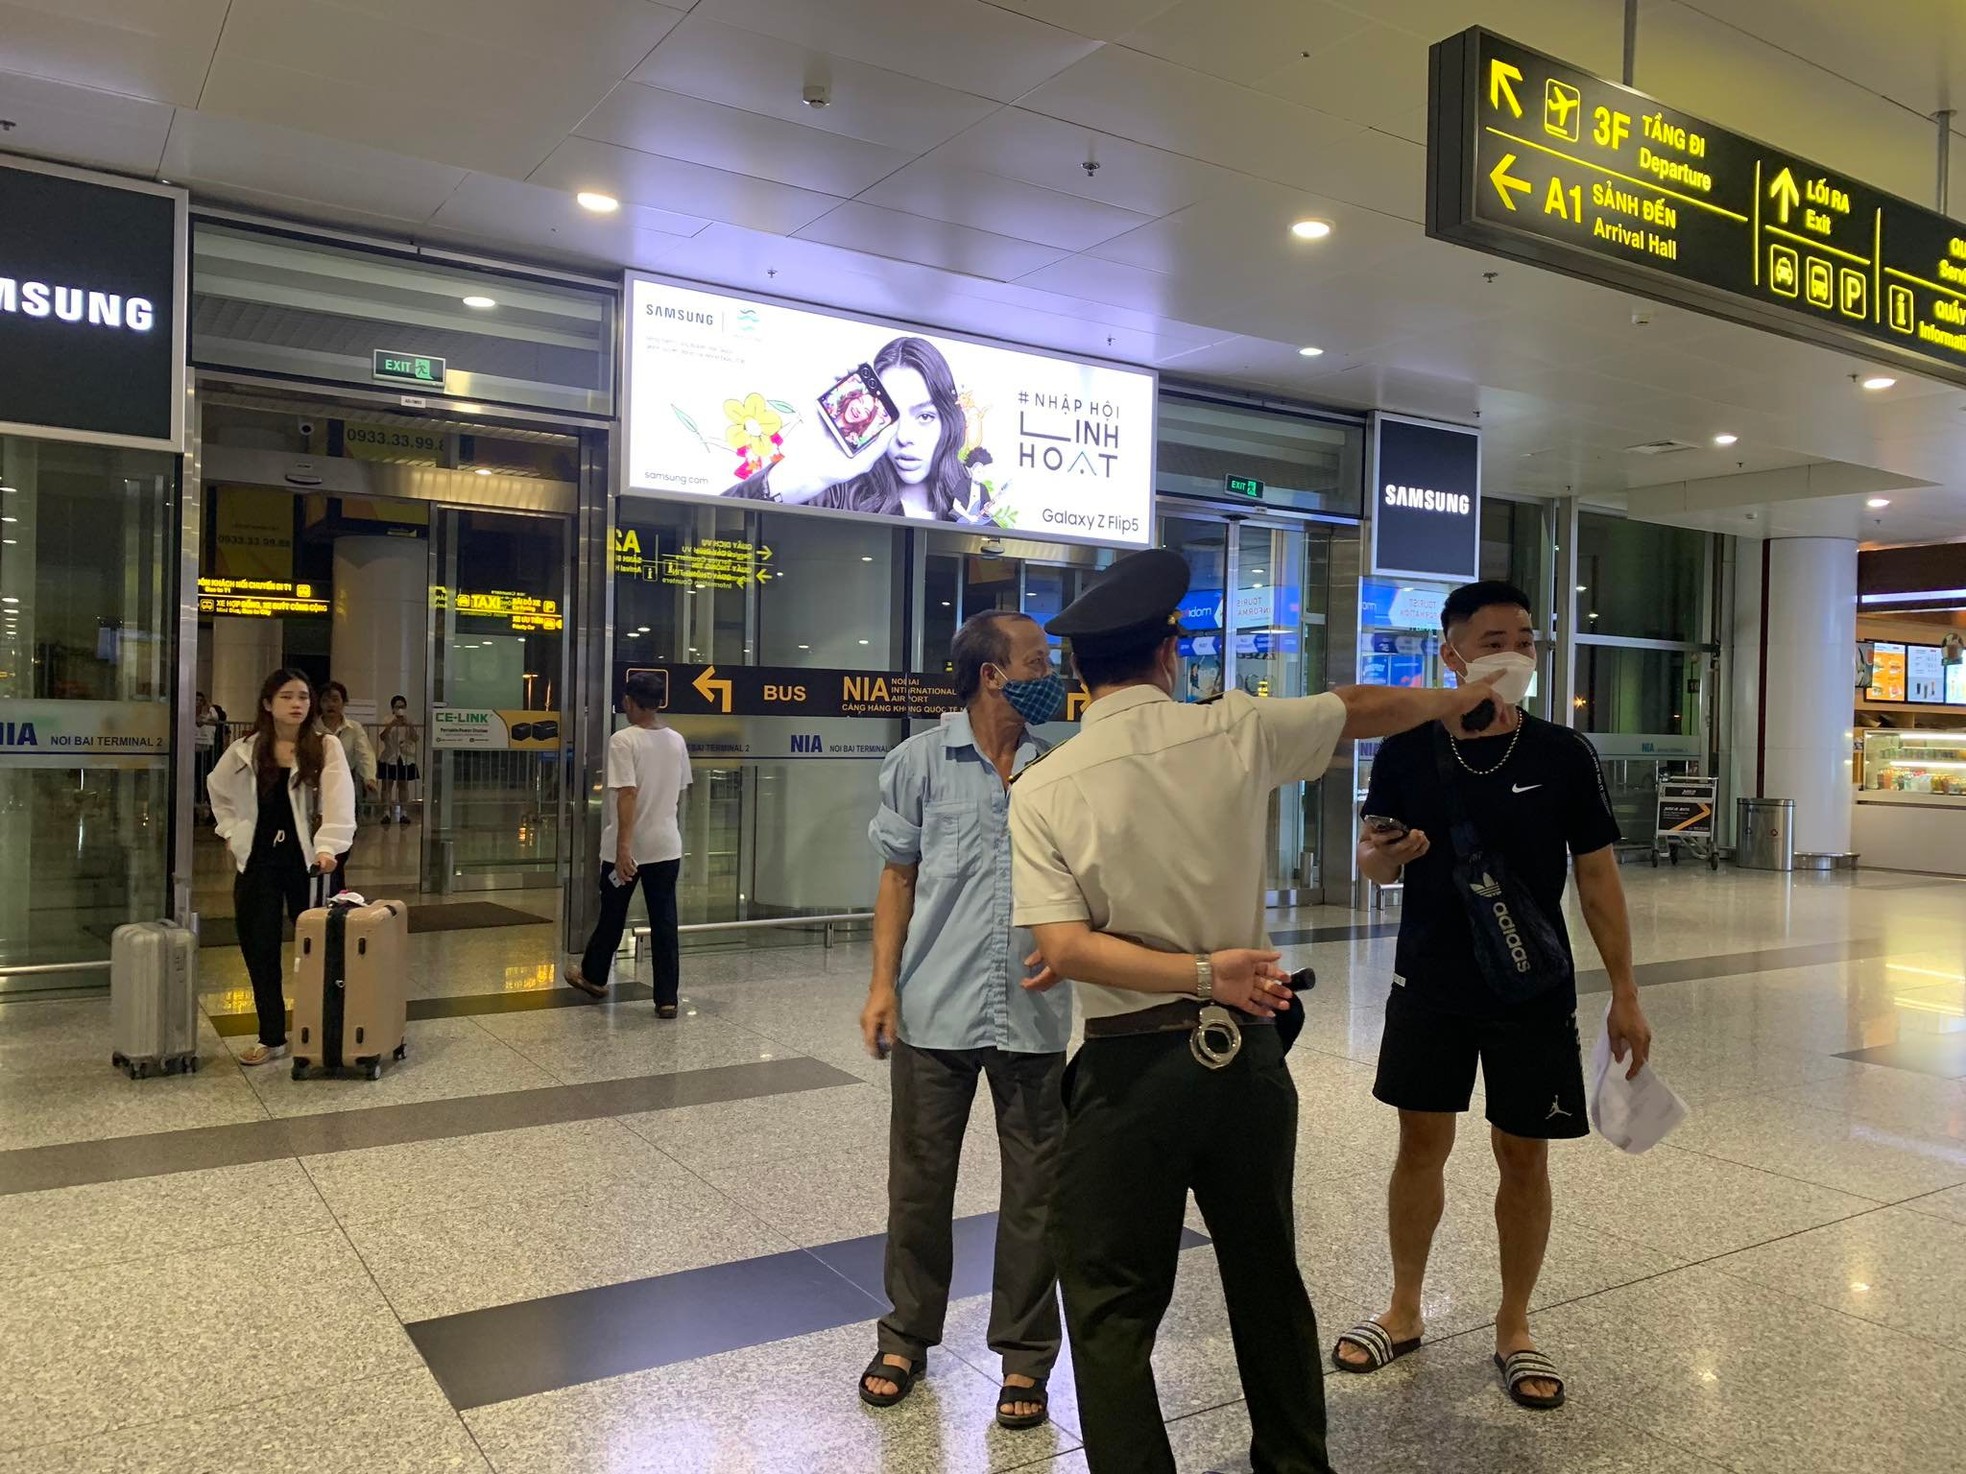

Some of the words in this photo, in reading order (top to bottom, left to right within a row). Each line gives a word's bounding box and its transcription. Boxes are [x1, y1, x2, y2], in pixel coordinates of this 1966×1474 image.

[1593, 106, 1631, 150] 3F
[1642, 111, 1686, 151] TẦNG
[1689, 133, 1706, 158] ĐI
[1639, 147, 1712, 192] Departure
[1544, 176, 1582, 224] A1
[1592, 180, 1639, 217] SẢNH
[1642, 197, 1677, 230] ĐẾN
[1806, 178, 1830, 206] LỐI
[1830, 189, 1850, 214] RA
[1805, 208, 1831, 235] Exit
[1593, 216, 1644, 250] Arrival
[1648, 232, 1677, 260] Hall
[646, 303, 713, 326] SAMSUNG
[385, 358, 411, 373] EXIT
[1090, 400, 1119, 422] HỘI
[1020, 411, 1118, 449] LINH
[1231, 480, 1246, 491] EXIT
[1385, 484, 1470, 515] SAMSUNG
[1042, 508, 1095, 530] Galaxy
[1097, 514, 1105, 528] Z
[1108, 515, 1139, 535] Flip5
[471, 595, 501, 609] TAXI
[763, 685, 807, 701] BUS
[843, 676, 891, 702] NIA
[435, 712, 489, 724] CE-LINK
[50, 736, 71, 746] NOI
[74, 737, 94, 746] BAI
[97, 737, 154, 747] TERMINAL
[156, 738, 163, 747] 2
[745, 745, 751, 753] 2
[791, 735, 823, 753] NIA
[829, 744, 841, 753] NOI
[843, 745, 855, 753] BAI
[856, 745, 889, 754] TERMINAL
[1492, 901, 1531, 974] adidas
